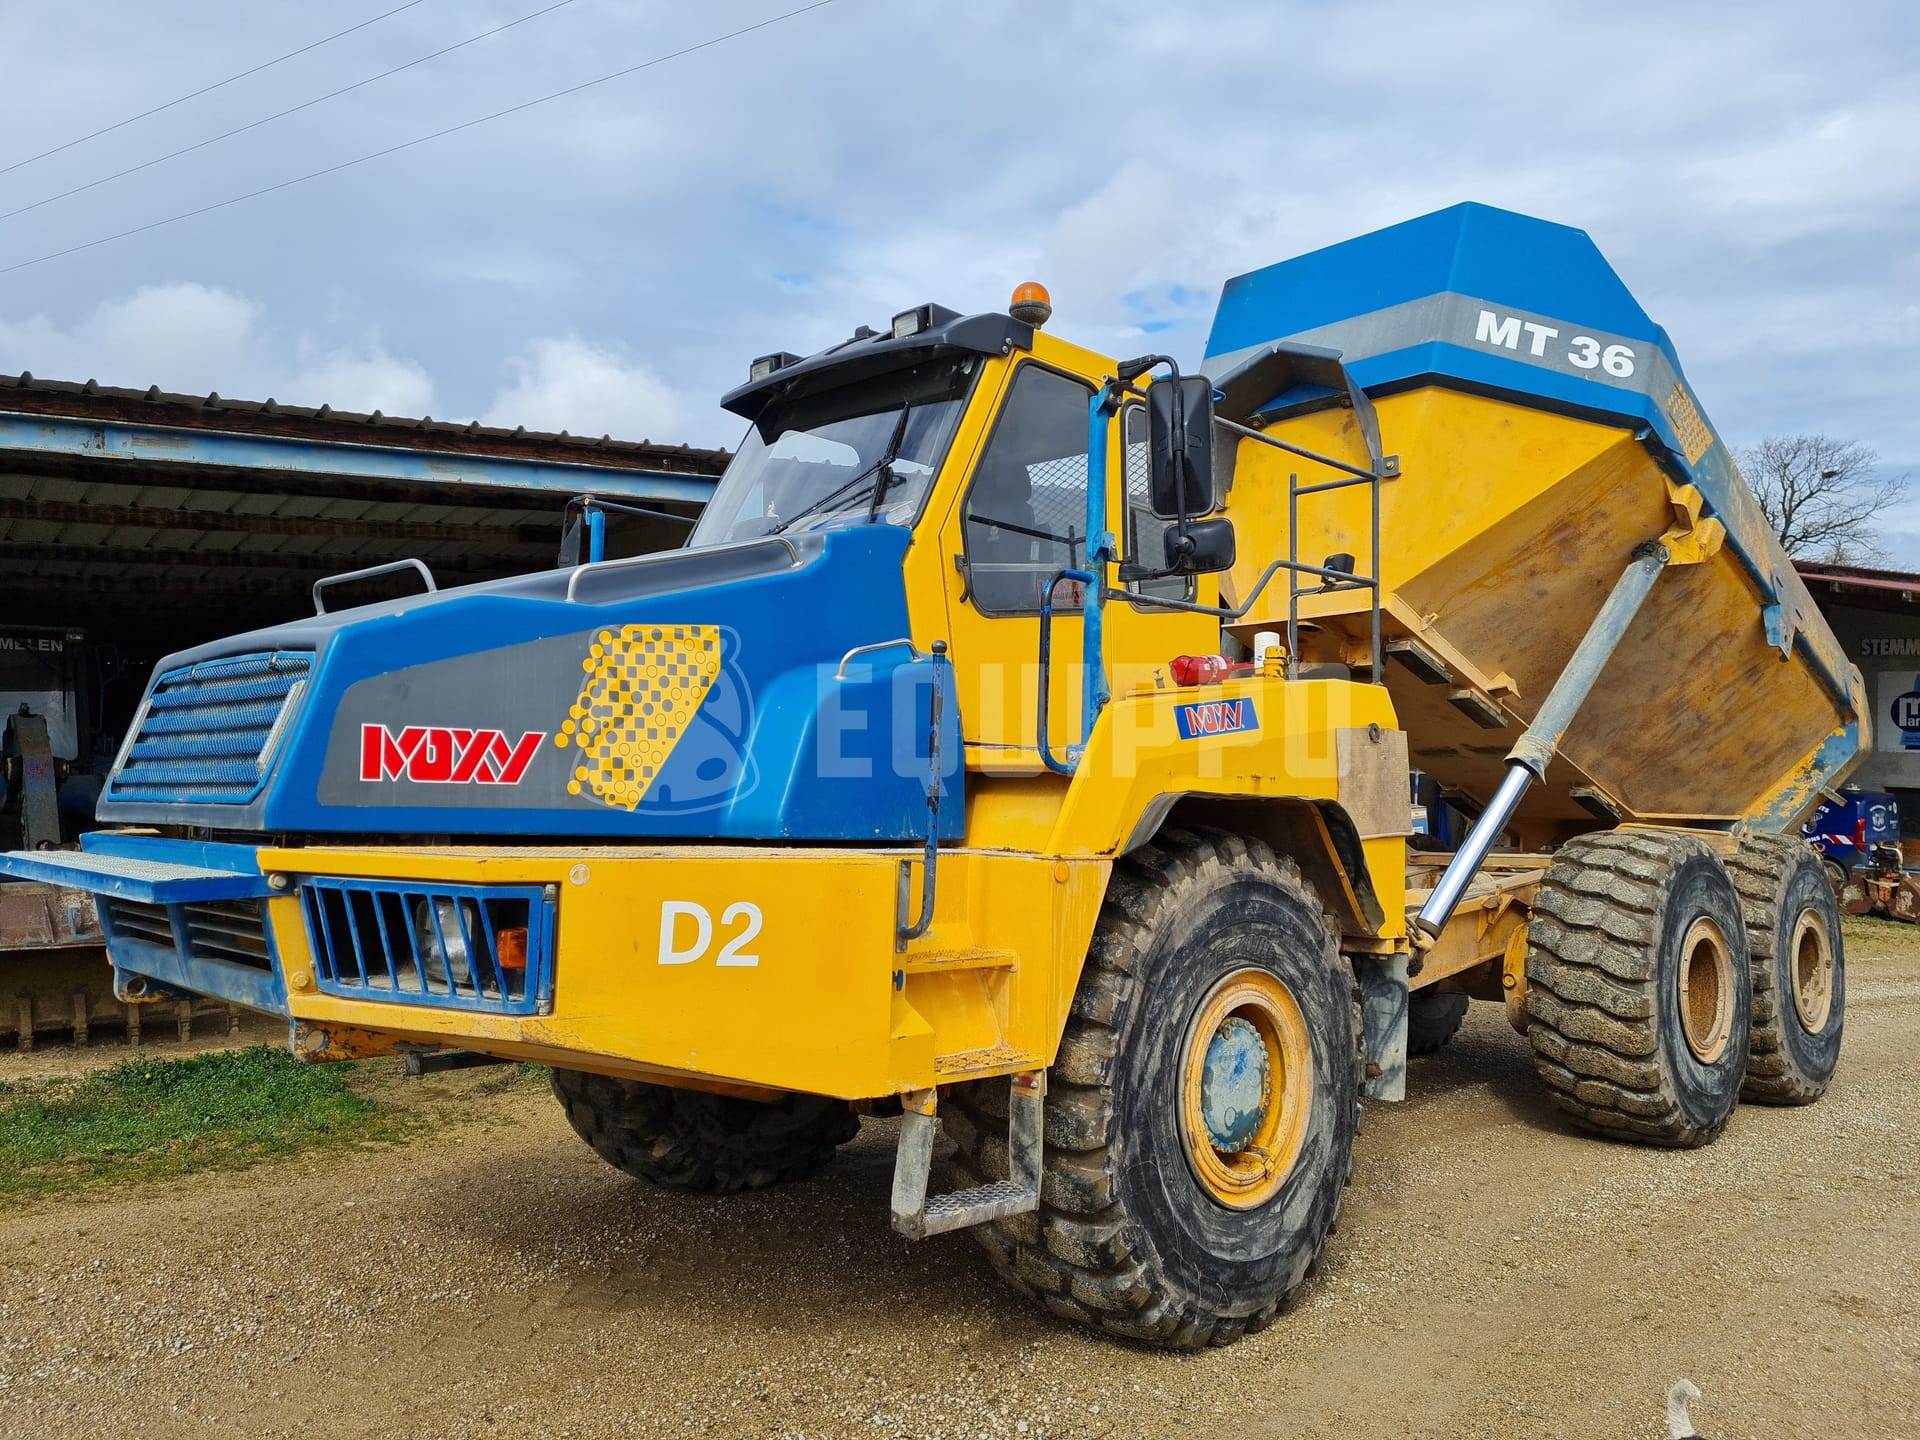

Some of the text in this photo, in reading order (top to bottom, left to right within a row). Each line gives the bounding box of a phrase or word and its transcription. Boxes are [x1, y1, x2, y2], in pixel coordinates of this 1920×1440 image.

[1474, 310, 1635, 378] MT 36
[1185, 701, 1243, 736] MOXY
[359, 723, 547, 785] MOXY
[657, 901, 763, 967] D2
